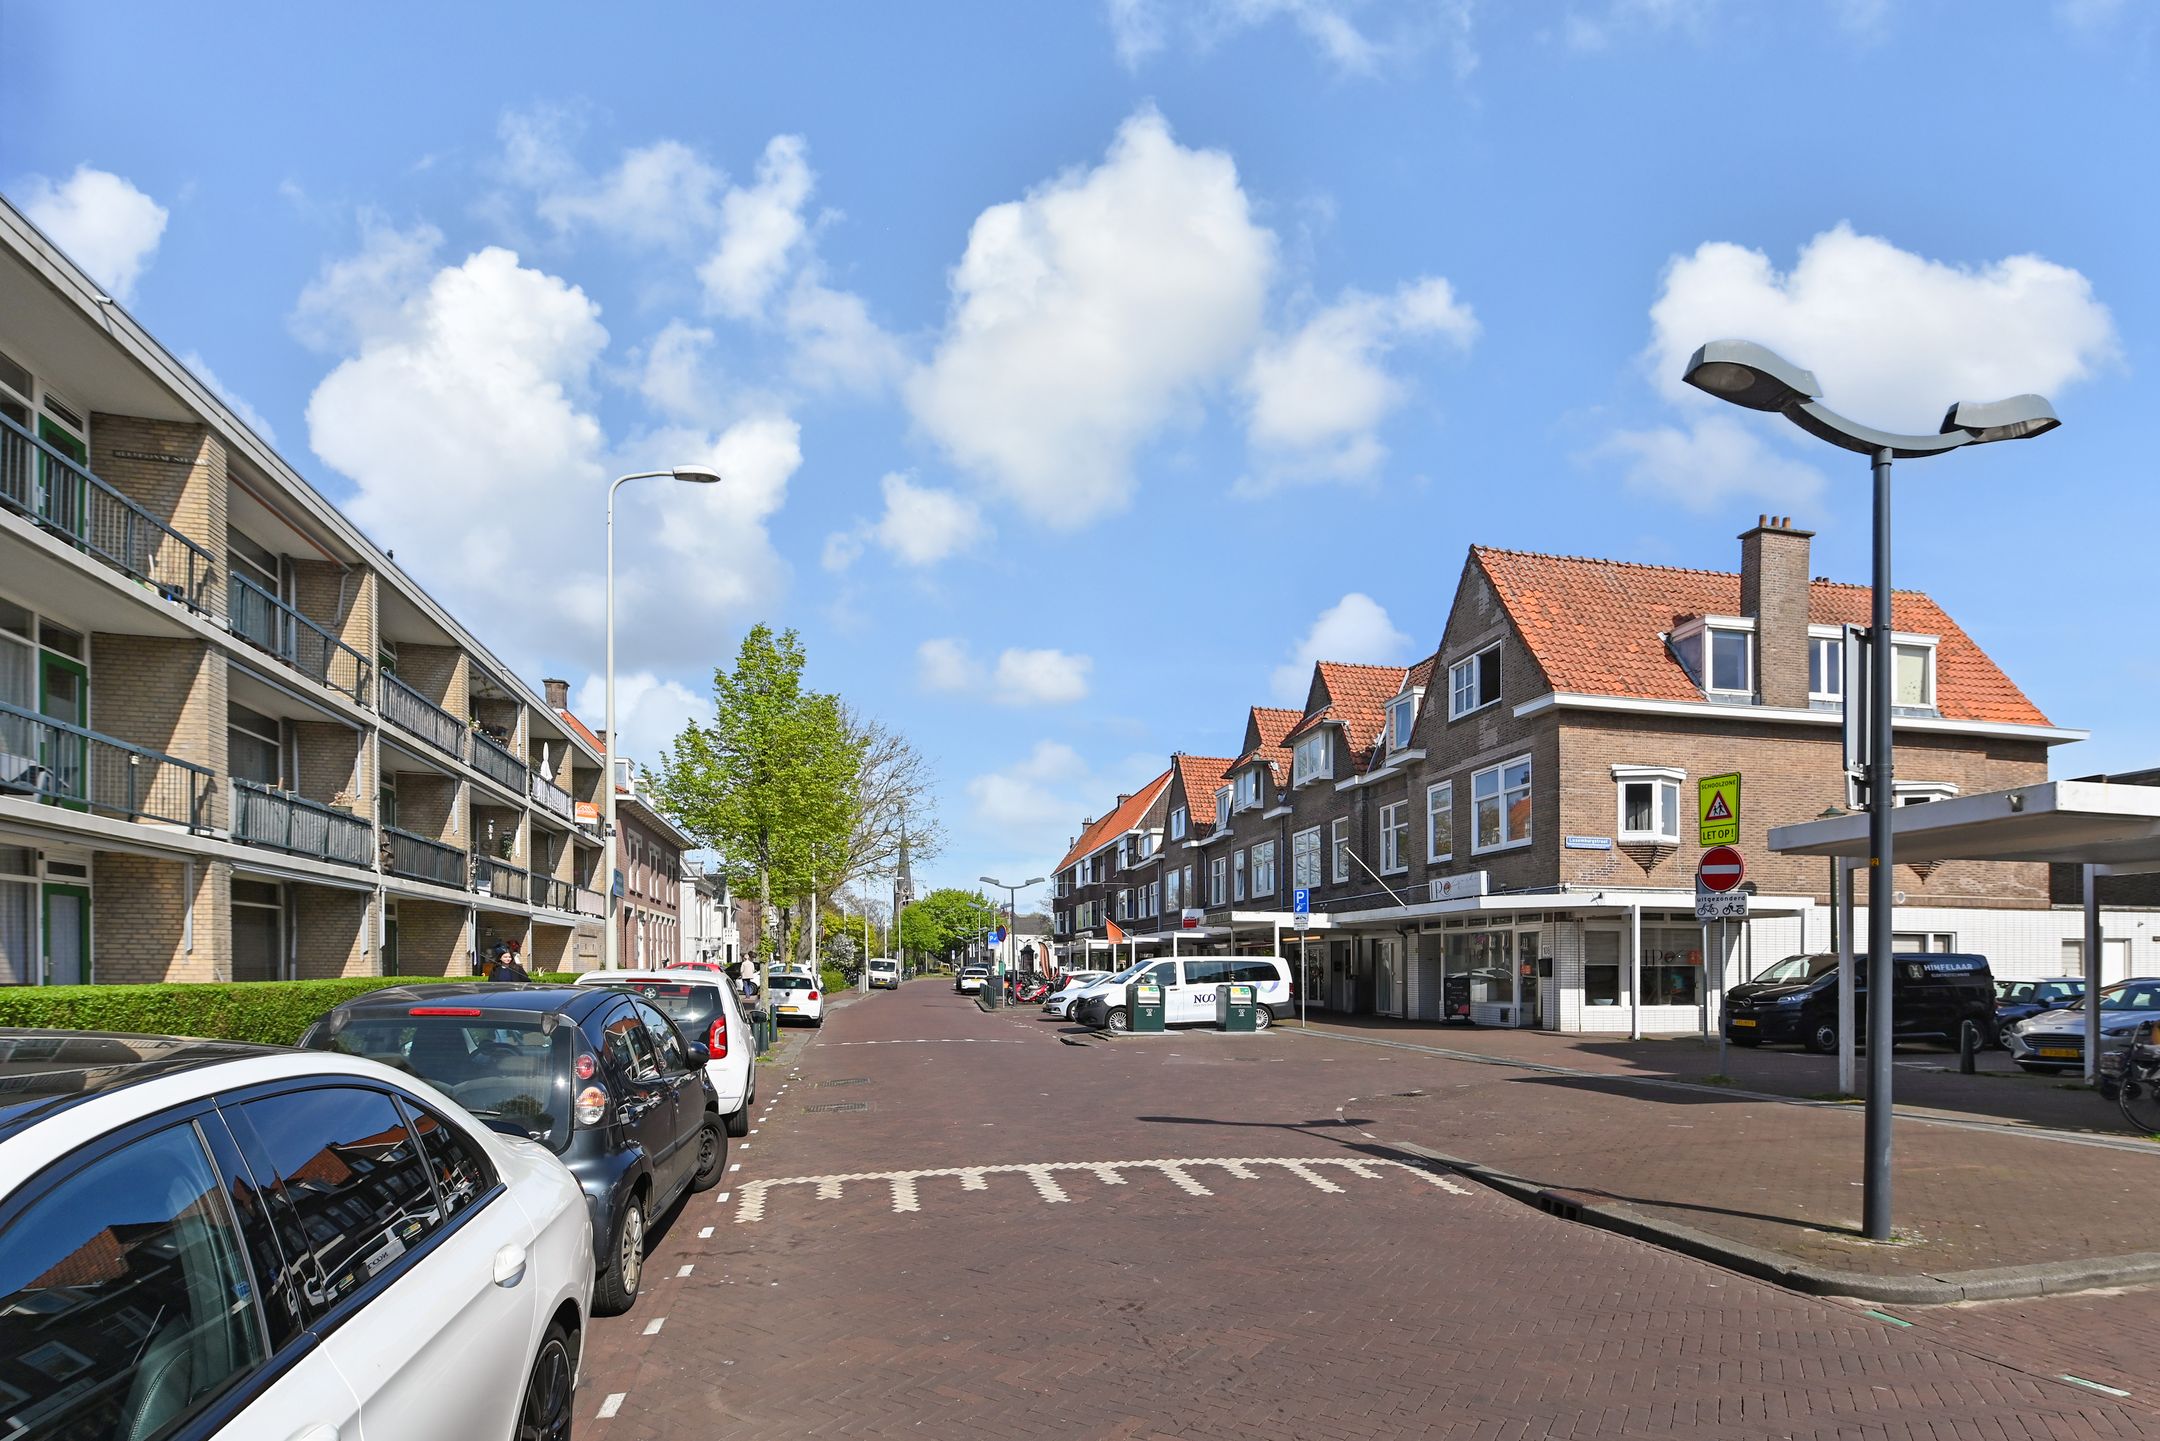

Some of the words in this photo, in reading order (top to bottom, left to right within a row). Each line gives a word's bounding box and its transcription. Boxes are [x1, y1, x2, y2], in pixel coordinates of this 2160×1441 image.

[1701, 779, 1737, 790] SCHOOLZONE
[1702, 830, 1716, 841] LET
[1296, 891, 1304, 903] P
[1696, 895, 1746, 903] uitgezonderd
[1194, 993, 1216, 1004] NOO
